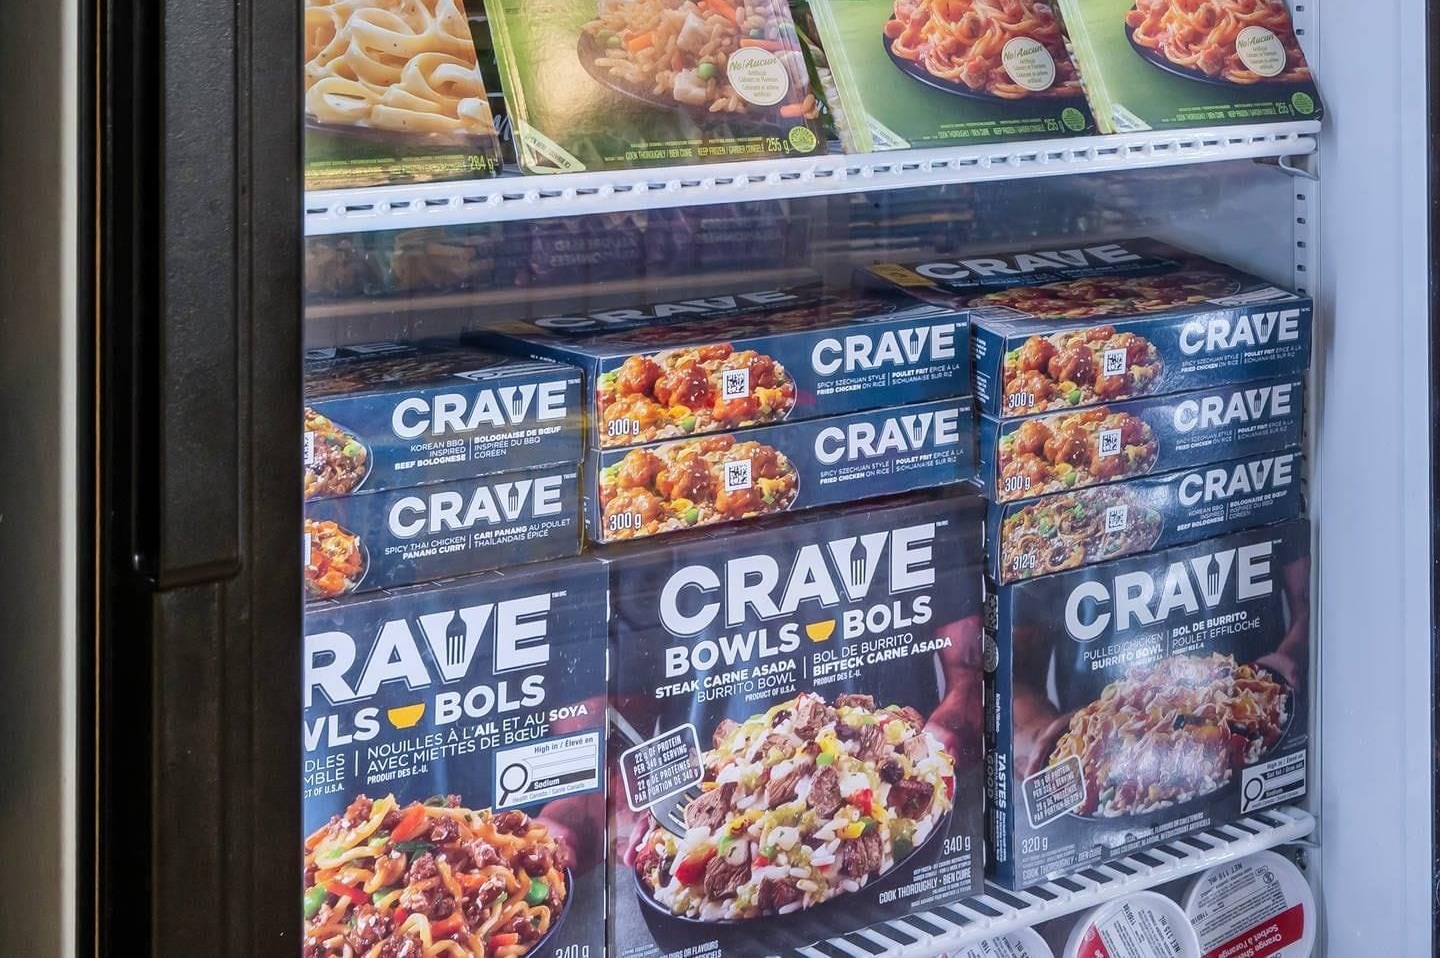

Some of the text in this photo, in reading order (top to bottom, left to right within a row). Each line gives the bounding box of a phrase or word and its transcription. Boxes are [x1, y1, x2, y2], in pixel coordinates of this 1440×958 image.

[468, 155, 487, 171] 284
[915, 243, 1141, 280] CRAVE
[811, 323, 956, 375] CRAVE
[1179, 309, 1300, 355] CRAVE
[391, 380, 568, 440] CRAVE
[1009, 392, 1035, 408] 300 g
[1173, 383, 1293, 432] CRAVE
[410, 439, 465, 453] KOREAN BBQ
[474, 425, 563, 444] BOLOGNAISE DE BŒUF
[607, 418, 640, 437] 300 g
[815, 409, 960, 466] CRAVE
[394, 453, 466, 471] BEEF BOLOGNESE
[1178, 454, 1294, 507] CRAVE
[1005, 476, 1031, 492] 300 g
[388, 476, 563, 539] CRAVE
[609, 512, 642, 531] 300 g
[659, 522, 936, 636] CRAVE
[1013, 554, 1029, 571] 312
[1063, 541, 1273, 643] CRAVE
[665, 595, 933, 679] BOWLS BOLS
[1083, 617, 1261, 661] PULLED CHICKEN POULET EFFILOCHÉ
[1172, 610, 1248, 638] BOL DE BURRITO
[655, 633, 914, 699] STEAK CARNE ASADA BOL DE BURRITO
[697, 637, 952, 704] BURRITO BOWL BIFTECK CARNE ASADA
[1091, 643, 1164, 671] BURRITO BOWL
[435, 674, 546, 725] BOLS
[367, 704, 588, 758] NOUILLES À L'AIL ET AU SOYA
[367, 755, 410, 774] AVEC
[413, 743, 474, 764] MIETTES
[476, 737, 500, 751] DE
[504, 725, 550, 745] BŒUF
[533, 743, 550, 755] High
[550, 742, 559, 751] in
[564, 737, 584, 750] Élevé
[584, 735, 594, 745] en
[533, 776, 561, 790] Sodium
[997, 753, 1007, 809] TASTES
[943, 835, 971, 856] 340 g
[1022, 836, 1048, 854] 320 g
[1253, 923, 1280, 941] Sorbet
[1255, 933, 1283, 951] Orange
